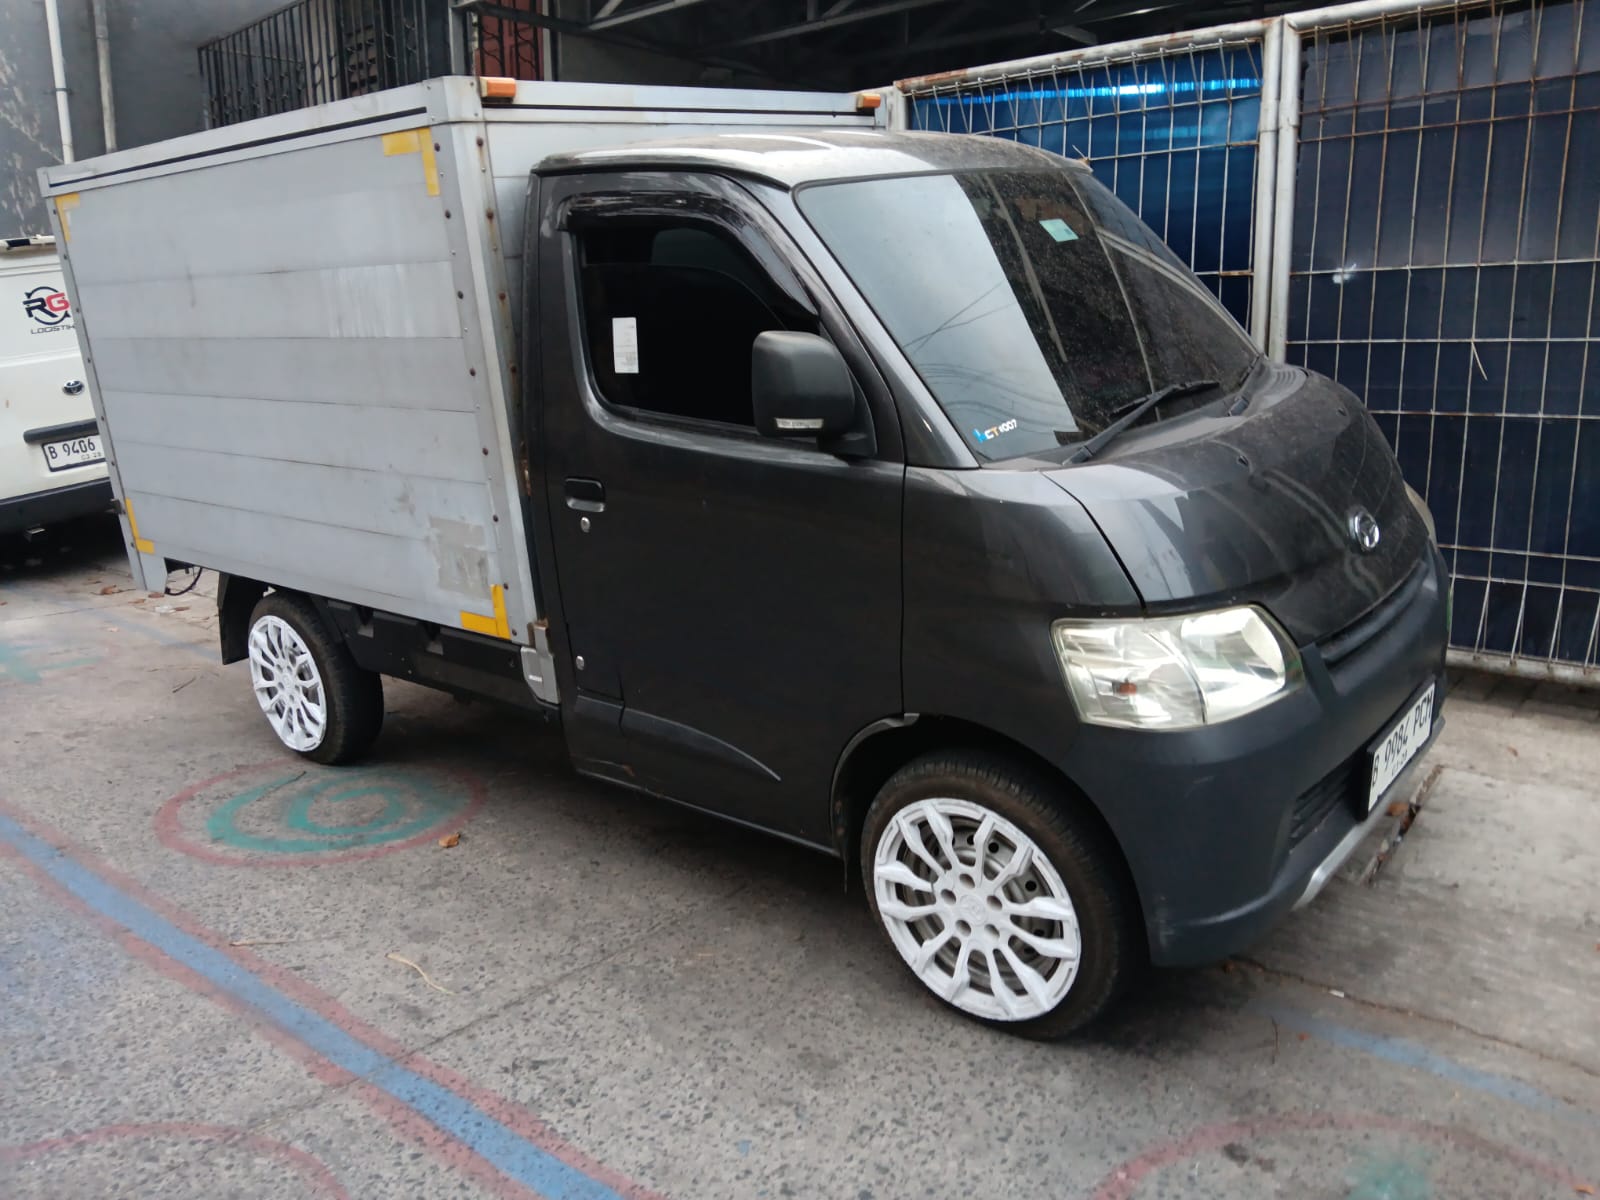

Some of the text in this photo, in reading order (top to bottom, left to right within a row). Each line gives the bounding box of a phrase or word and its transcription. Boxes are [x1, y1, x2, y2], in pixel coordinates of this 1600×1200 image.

[48, 438, 96, 460] B 9406
[1372, 753, 1380, 788] B
[1385, 716, 1409, 771] 9984
